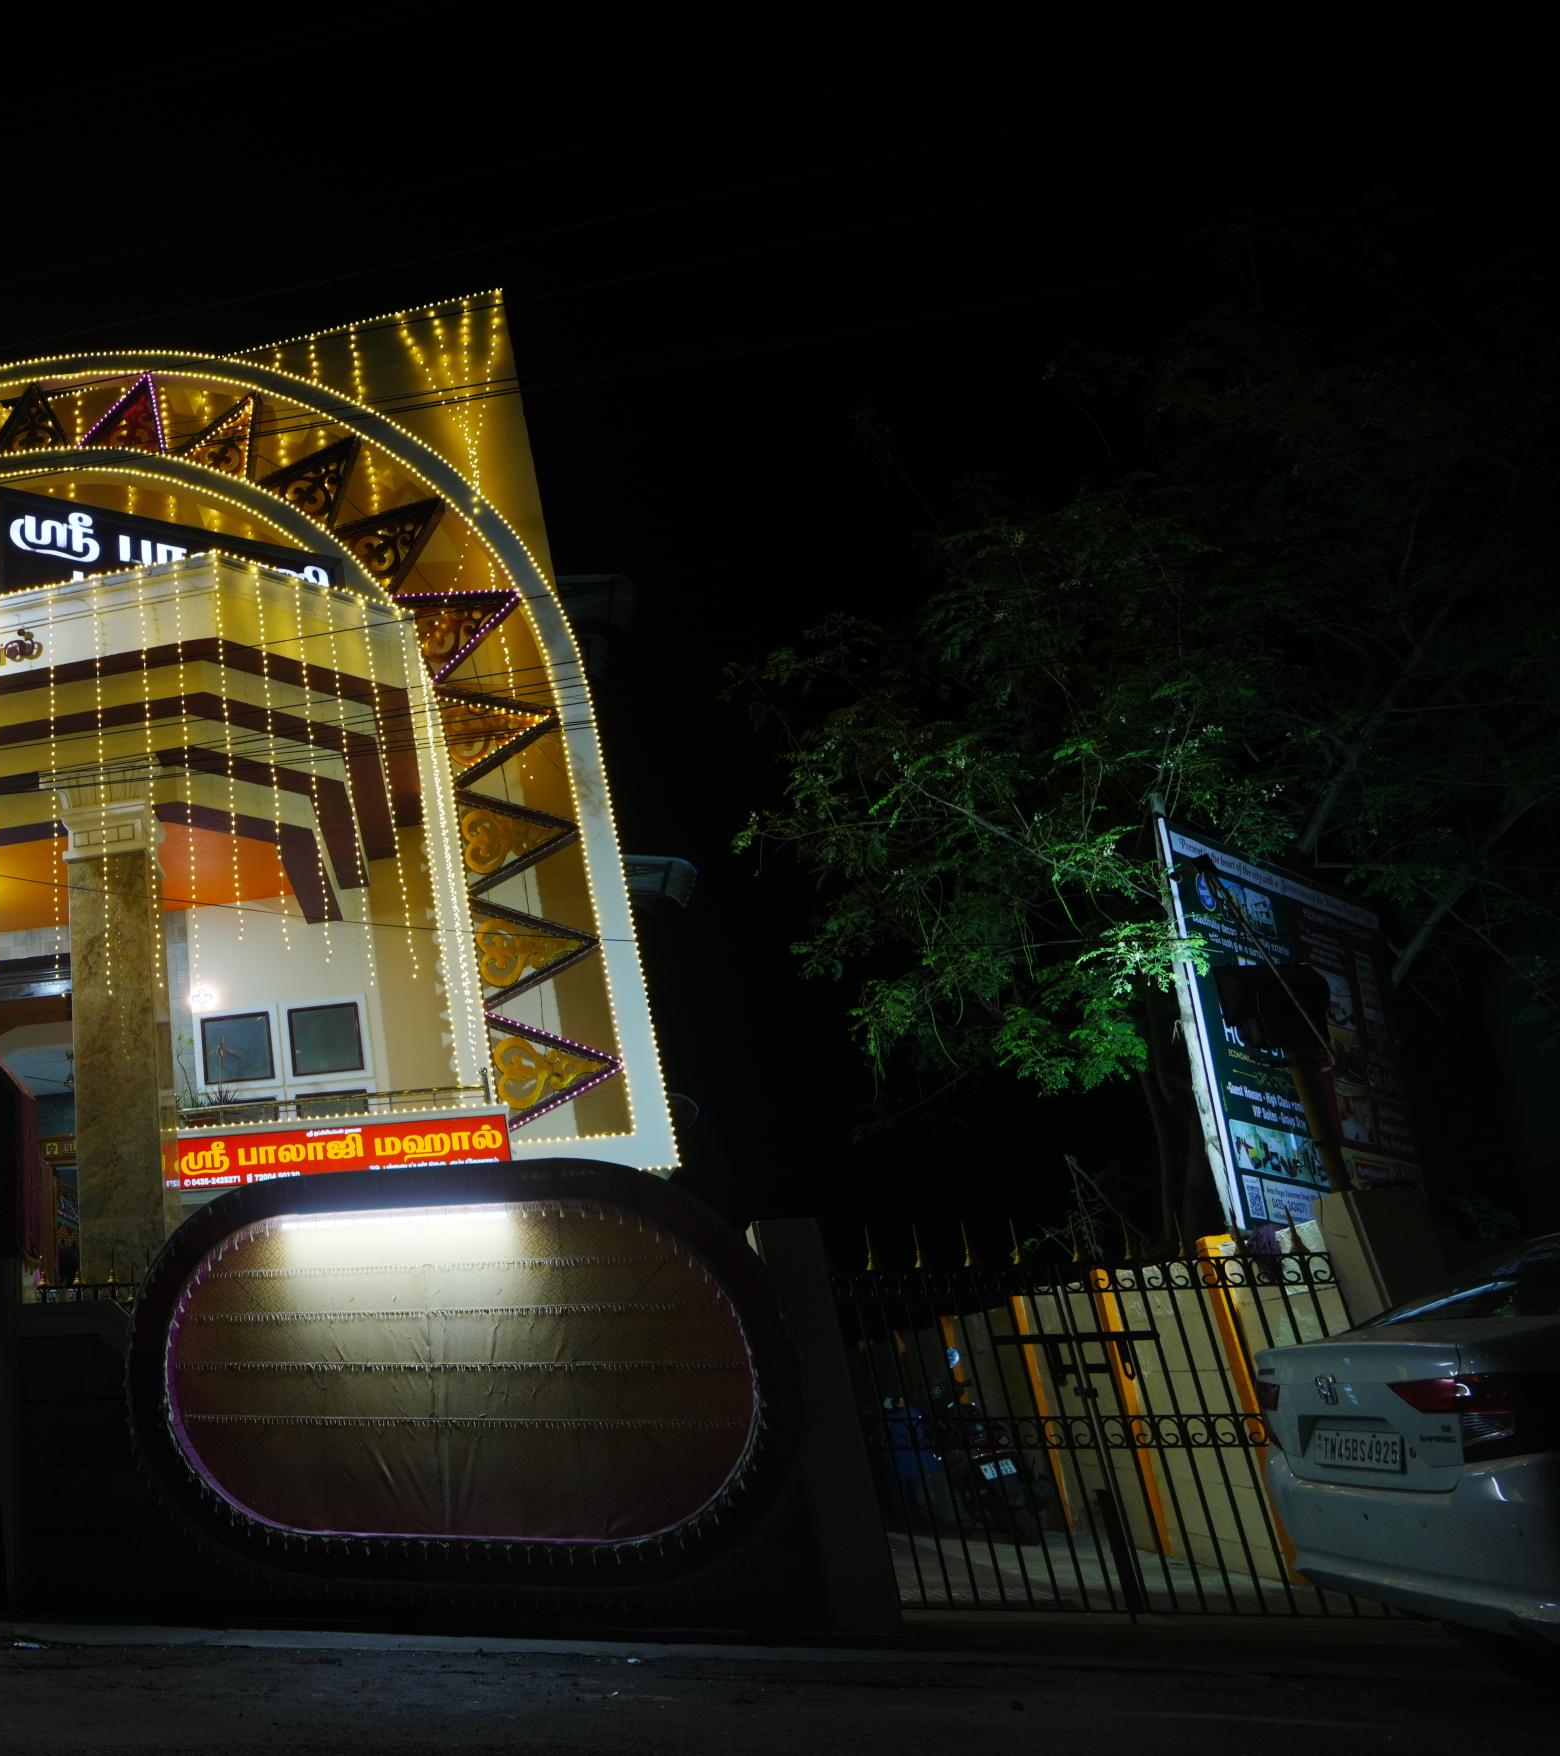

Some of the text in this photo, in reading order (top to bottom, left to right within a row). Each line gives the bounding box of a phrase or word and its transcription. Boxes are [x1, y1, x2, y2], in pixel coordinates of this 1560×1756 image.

[237, 1134, 364, 1167] பாலாஜி
[374, 1124, 504, 1163] மஹால்
[1323, 1436, 1399, 1466] TN45BS4925
